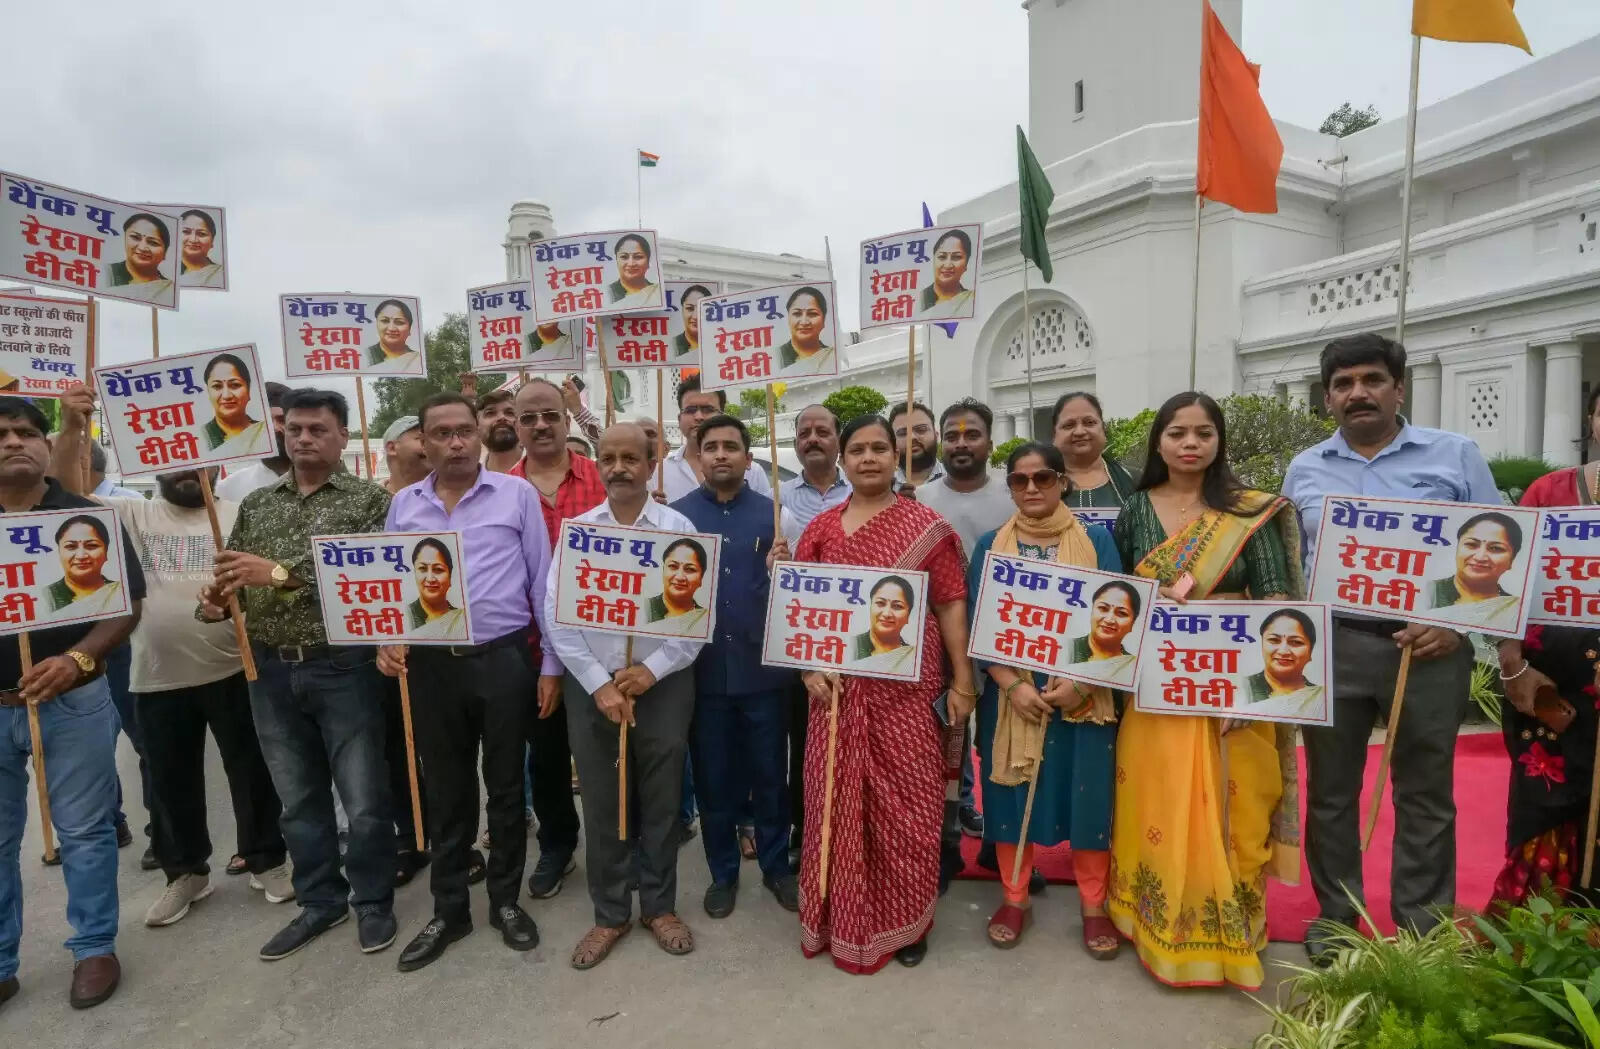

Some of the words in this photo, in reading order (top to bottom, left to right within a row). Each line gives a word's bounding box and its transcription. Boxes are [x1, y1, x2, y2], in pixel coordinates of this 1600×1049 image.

[5, 177, 78, 217] थैंक
[84, 204, 120, 236] यू
[20, 214, 105, 260] रेखा
[532, 241, 580, 262] थैंक
[585, 241, 613, 261] यू
[864, 240, 904, 264] थैंक
[906, 239, 931, 263] यू
[24, 251, 100, 289] दीदी
[545, 266, 604, 290] रेखा
[869, 269, 920, 296] रेखा
[46, 308, 60, 320] की
[286, 297, 338, 318] थैंक
[344, 302, 373, 324] यू
[470, 292, 504, 311] थैंक
[508, 290, 531, 311] यू
[552, 288, 604, 314] दीदी
[703, 298, 751, 322] थैंक
[756, 295, 784, 320] यू
[871, 295, 916, 322] दीदी
[299, 322, 363, 347] रेखा
[478, 315, 522, 339] रेखा
[713, 326, 774, 353] रेखा
[304, 348, 363, 371] दीदी
[482, 338, 522, 362] दीदी
[616, 339, 668, 363] दीदी
[100, 369, 163, 397] थैंक
[167, 366, 204, 394] यू
[718, 352, 773, 381] दीदी
[124, 401, 195, 436] रेखा
[136, 431, 201, 465] दीदी
[1331, 500, 1403, 533] थैंक
[1412, 513, 1452, 547] यू
[6, 525, 53, 554] यू
[567, 526, 623, 556] थैंक
[630, 539, 660, 568] यू
[319, 541, 375, 568] थैंक
[383, 543, 411, 573] यू
[1338, 535, 1431, 577] रेखा
[335, 573, 403, 605] रेखा
[576, 559, 646, 595] रेखा
[779, 568, 833, 595] थैंक
[838, 577, 867, 605] यू
[992, 558, 1052, 592] थैंक
[1057, 576, 1088, 609] यू
[1337, 575, 1421, 611] दीदी
[343, 607, 403, 636] दीदी
[576, 594, 639, 627] दीदी
[785, 598, 854, 633] रेखा
[997, 591, 1072, 635] रेखा
[1217, 612, 1256, 643] यू
[784, 632, 847, 665] दीदी
[995, 628, 1062, 666] दीदी
[1157, 640, 1241, 673] रेखा
[1161, 677, 1237, 708] दीदी
